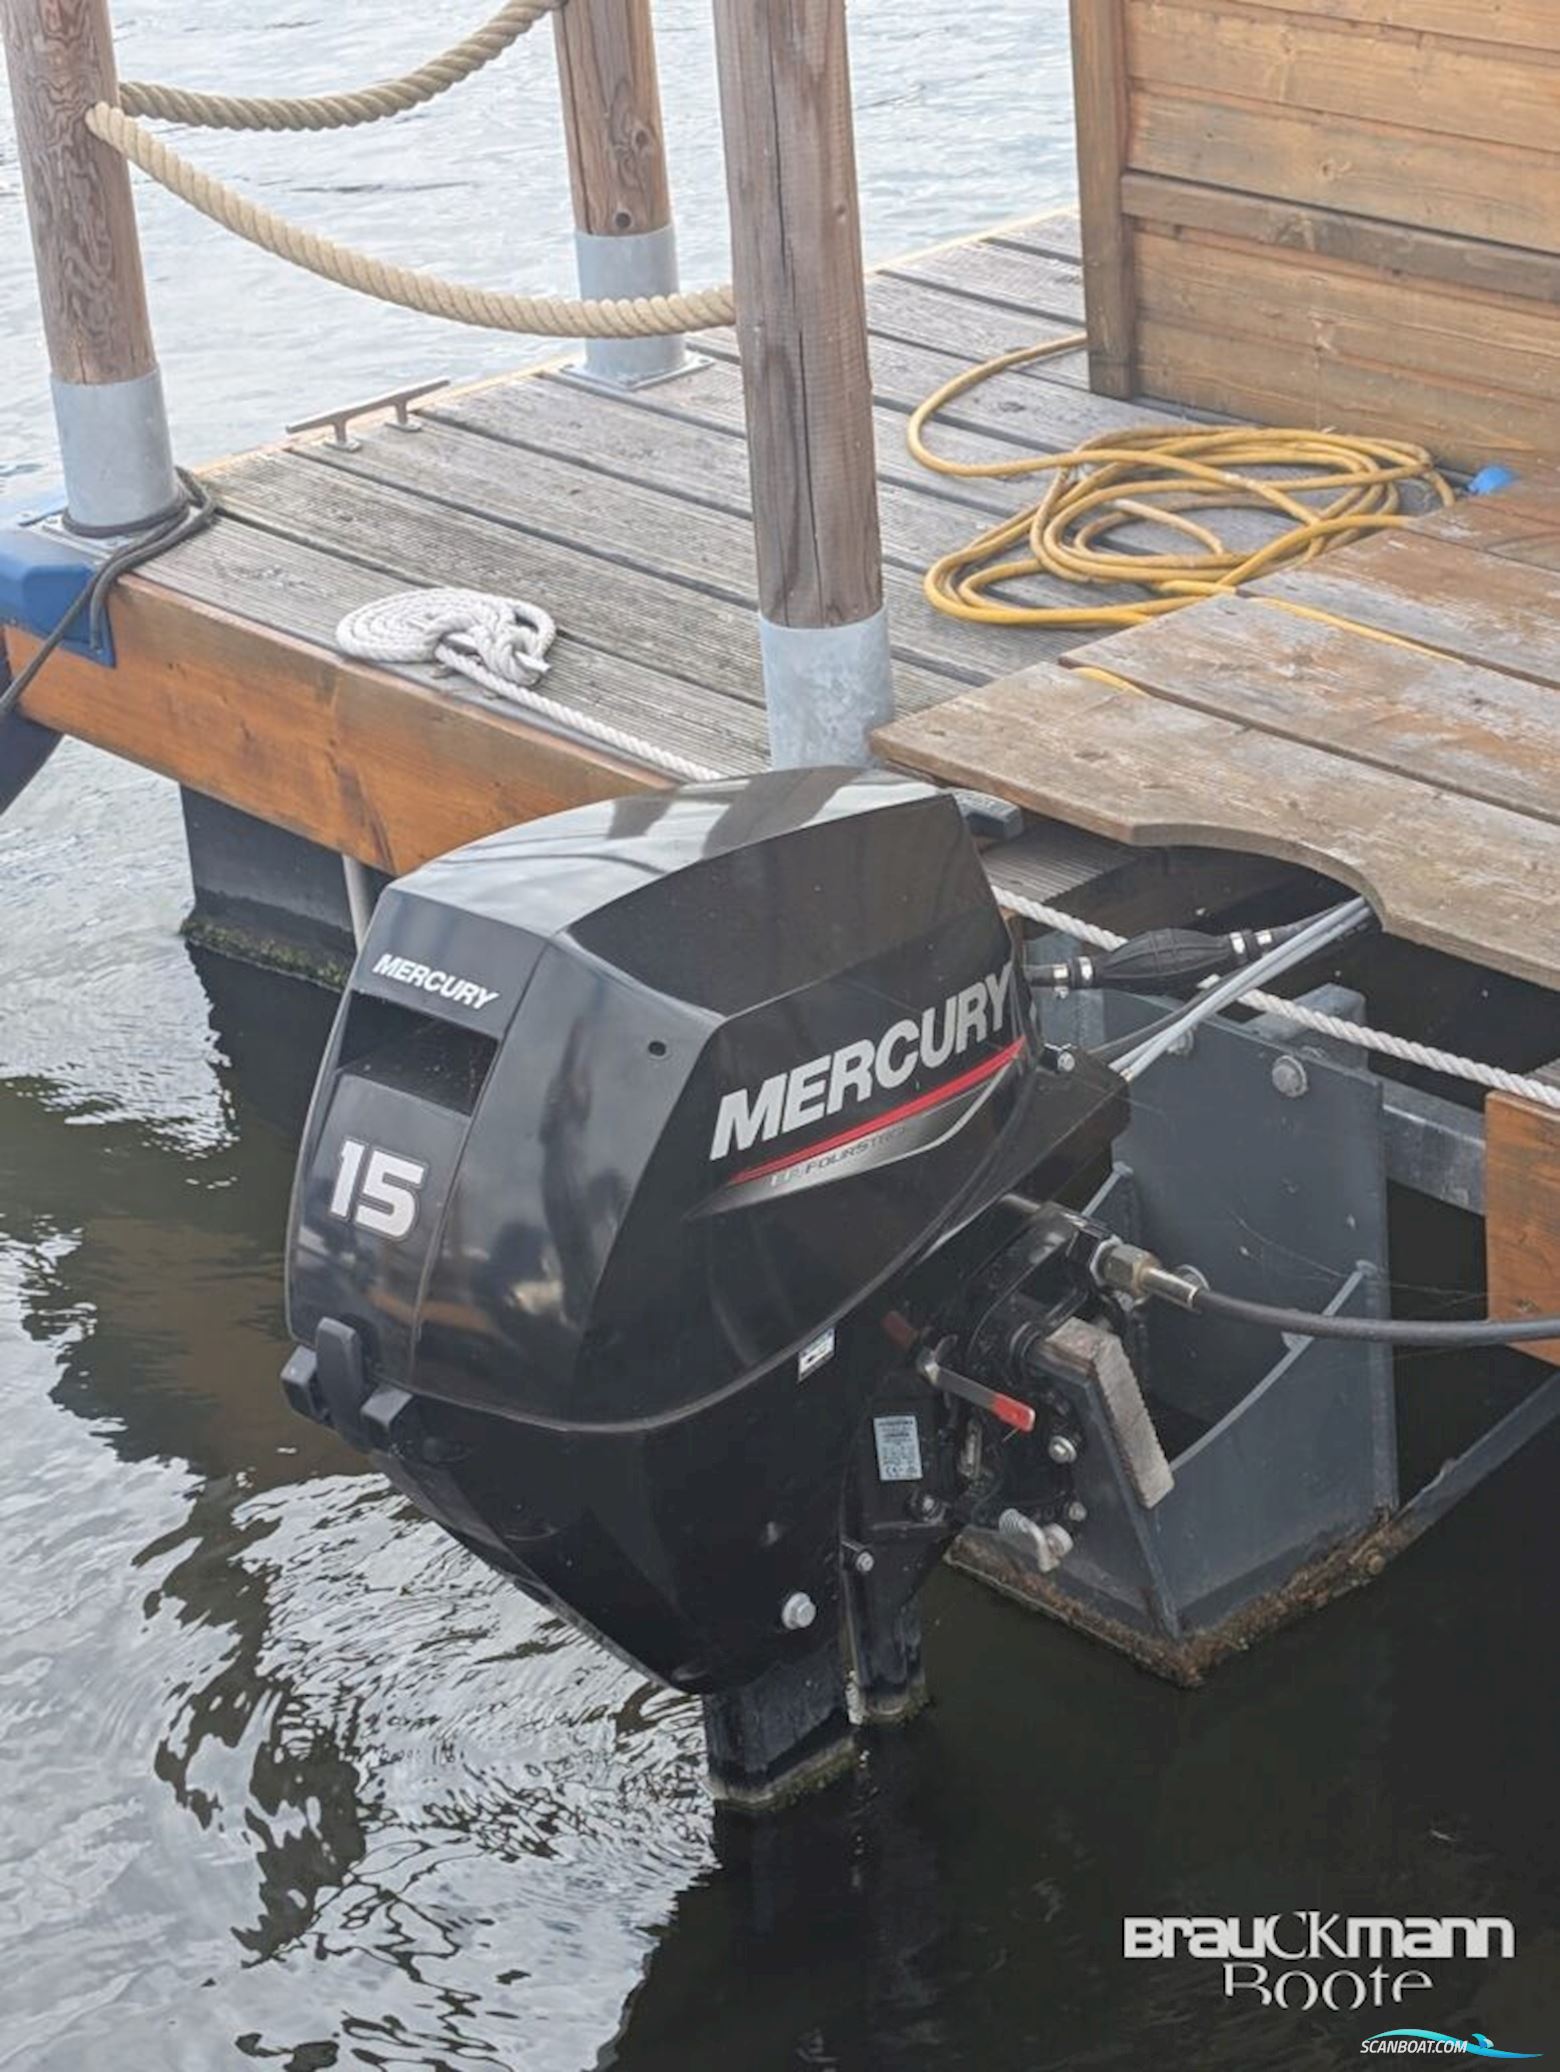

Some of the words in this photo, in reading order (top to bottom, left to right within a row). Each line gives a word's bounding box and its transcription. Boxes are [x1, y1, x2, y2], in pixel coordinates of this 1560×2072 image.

[371, 953, 500, 1010] MERCURY
[709, 960, 1013, 1161] MERCURY
[328, 1138, 426, 1239] 15
